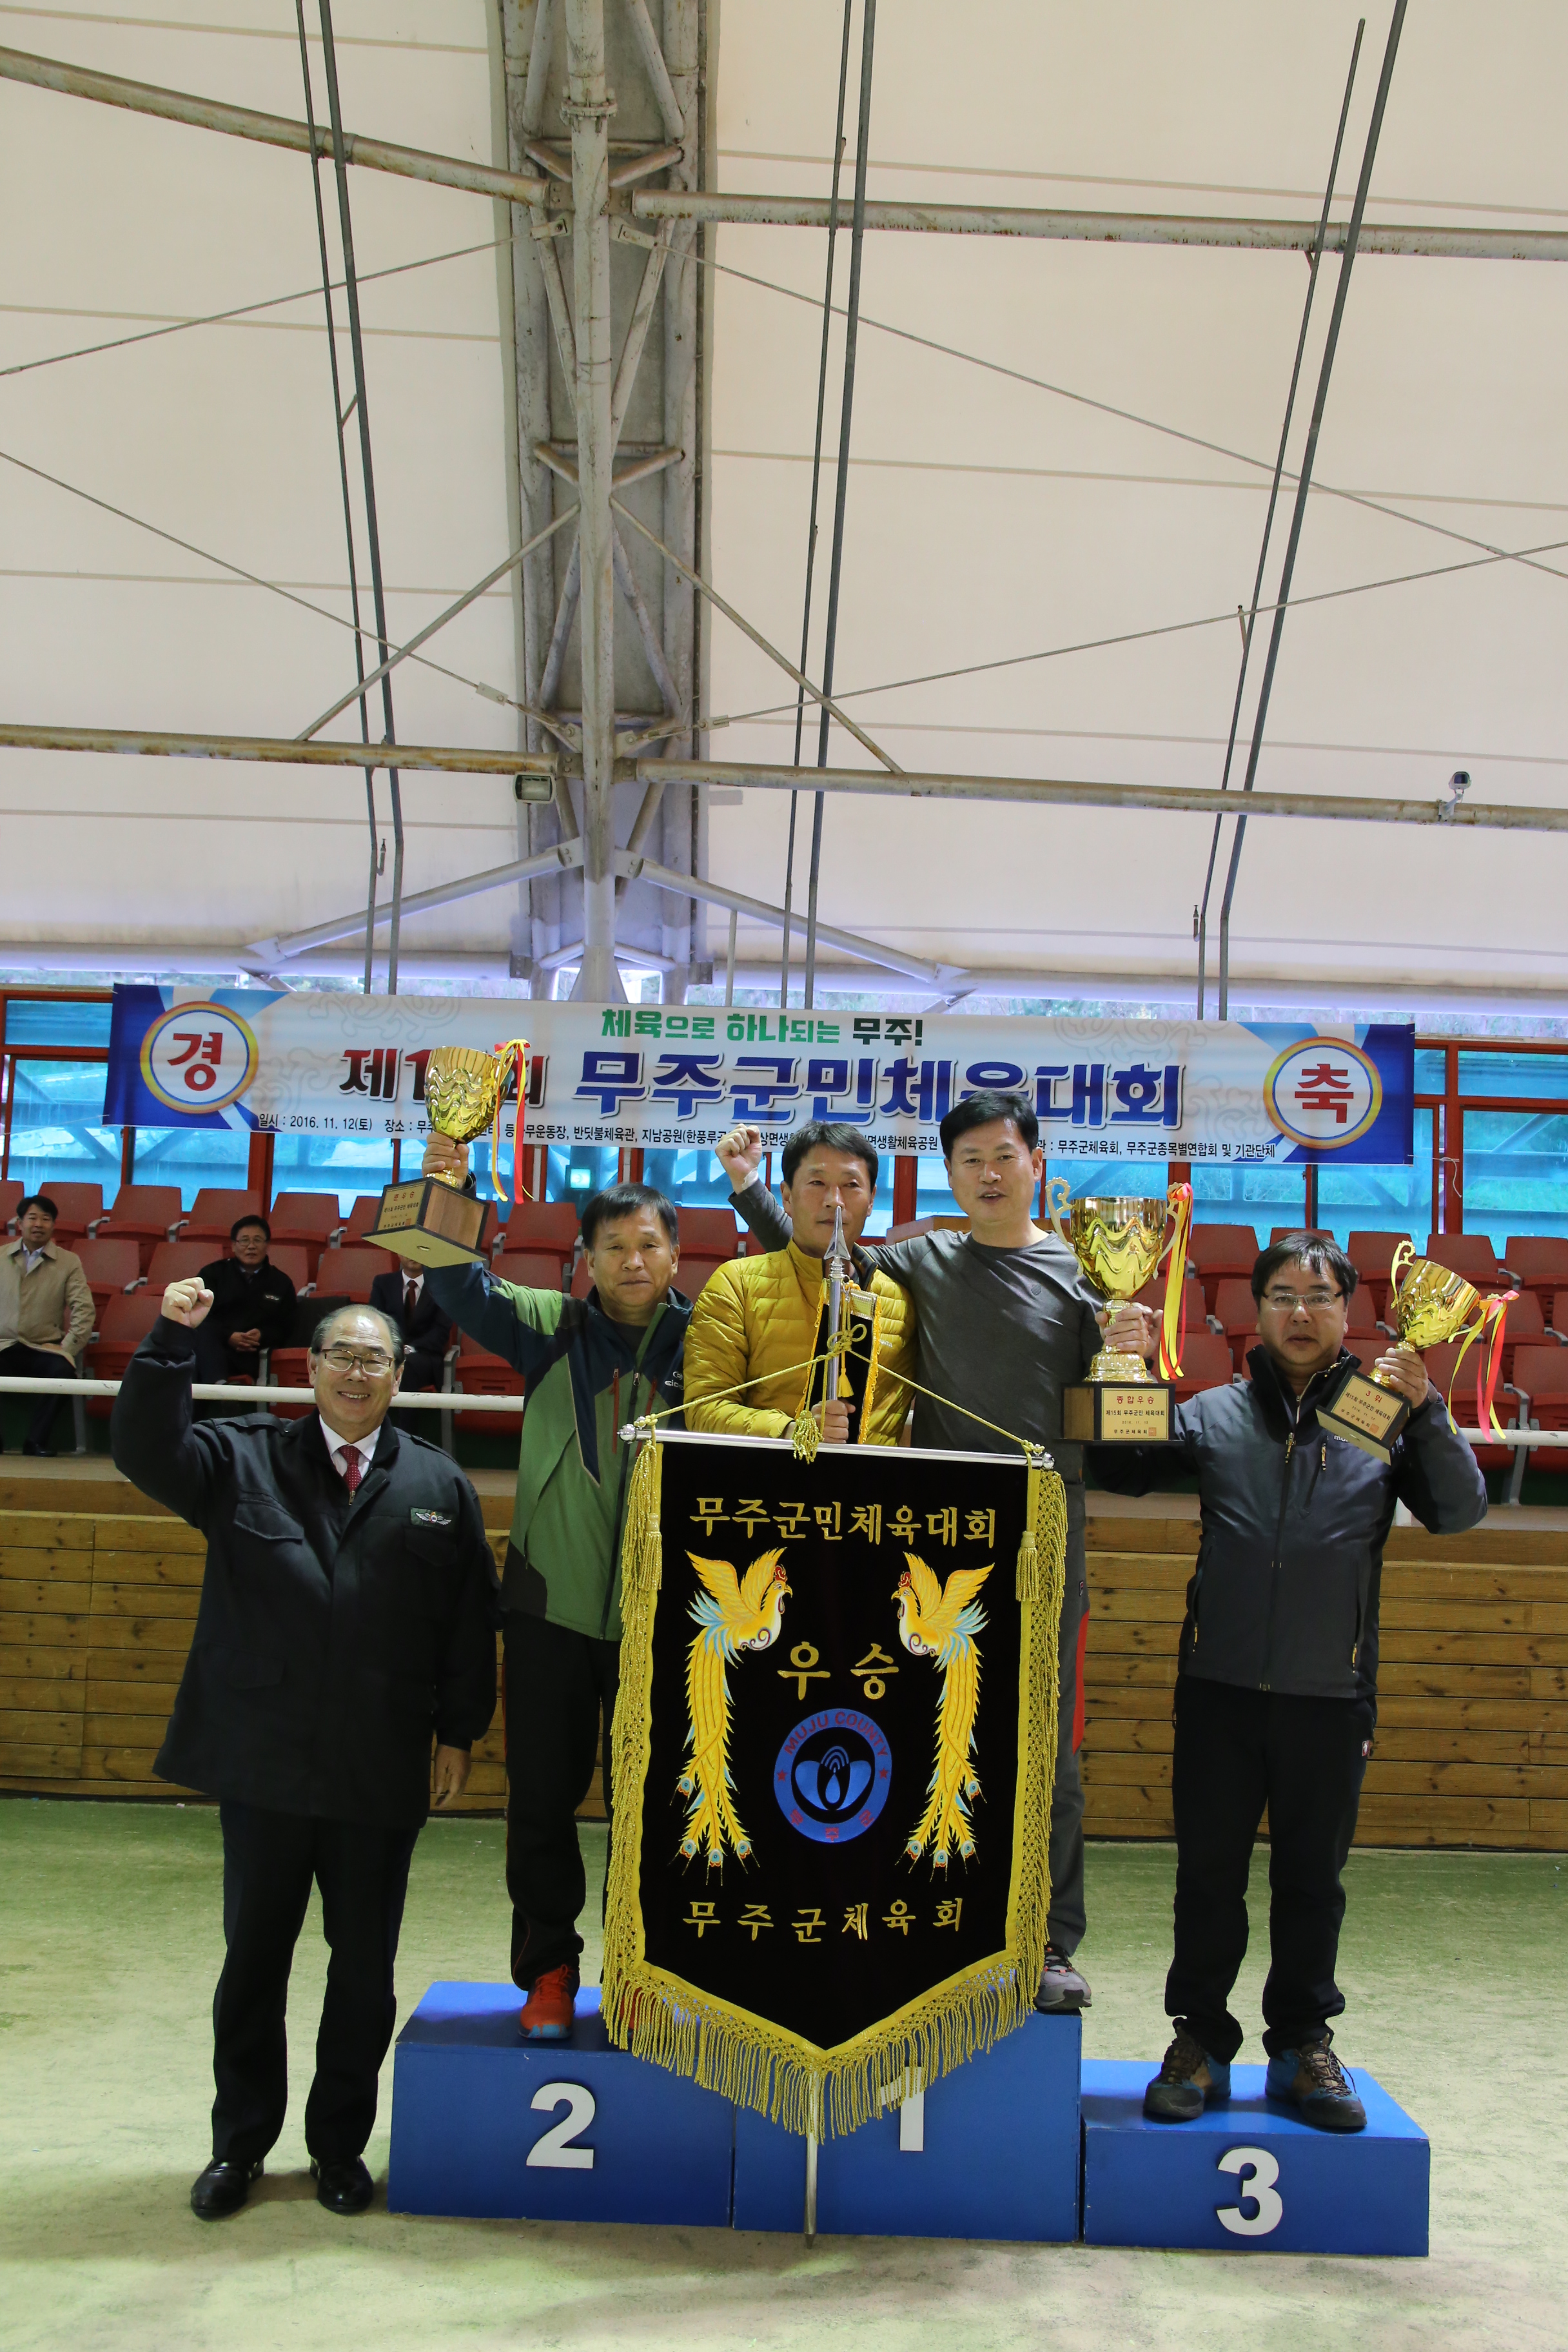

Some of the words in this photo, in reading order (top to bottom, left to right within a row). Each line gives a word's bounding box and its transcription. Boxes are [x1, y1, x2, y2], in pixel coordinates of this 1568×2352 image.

[601, 1008, 715, 1040] 체육으로
[727, 1013, 841, 1044] 하나되는
[852, 1017, 923, 1046] 무주!
[167, 1032, 223, 1092] 경
[338, 1048, 545, 1106] 제1회
[1294, 1063, 1354, 1124] 축
[259, 1113, 279, 1128] 일시
[290, 1116, 318, 1128] 2016.
[324, 1117, 338, 1129] 11.
[343, 1117, 372, 1131] 12(토)
[385, 1119, 405, 1133] 장소
[574, 1126, 637, 1142] 반딧불체육관,
[1058, 1140, 1122, 1155] 무주군체육회,
[1126, 1141, 1217, 1157] 무주군종목별연합회
[1222, 1144, 1231, 1157] 및
[1235, 1144, 1275, 1158] 기관단체
[689, 1497, 996, 1549] 무주군민체육대회
[784, 1714, 829, 1756] MUJU
[834, 1711, 888, 1757] COUNTY
[525, 2081, 597, 2170] 2
[877, 2066, 925, 2151] 1
[1216, 2146, 1283, 2237] 3
